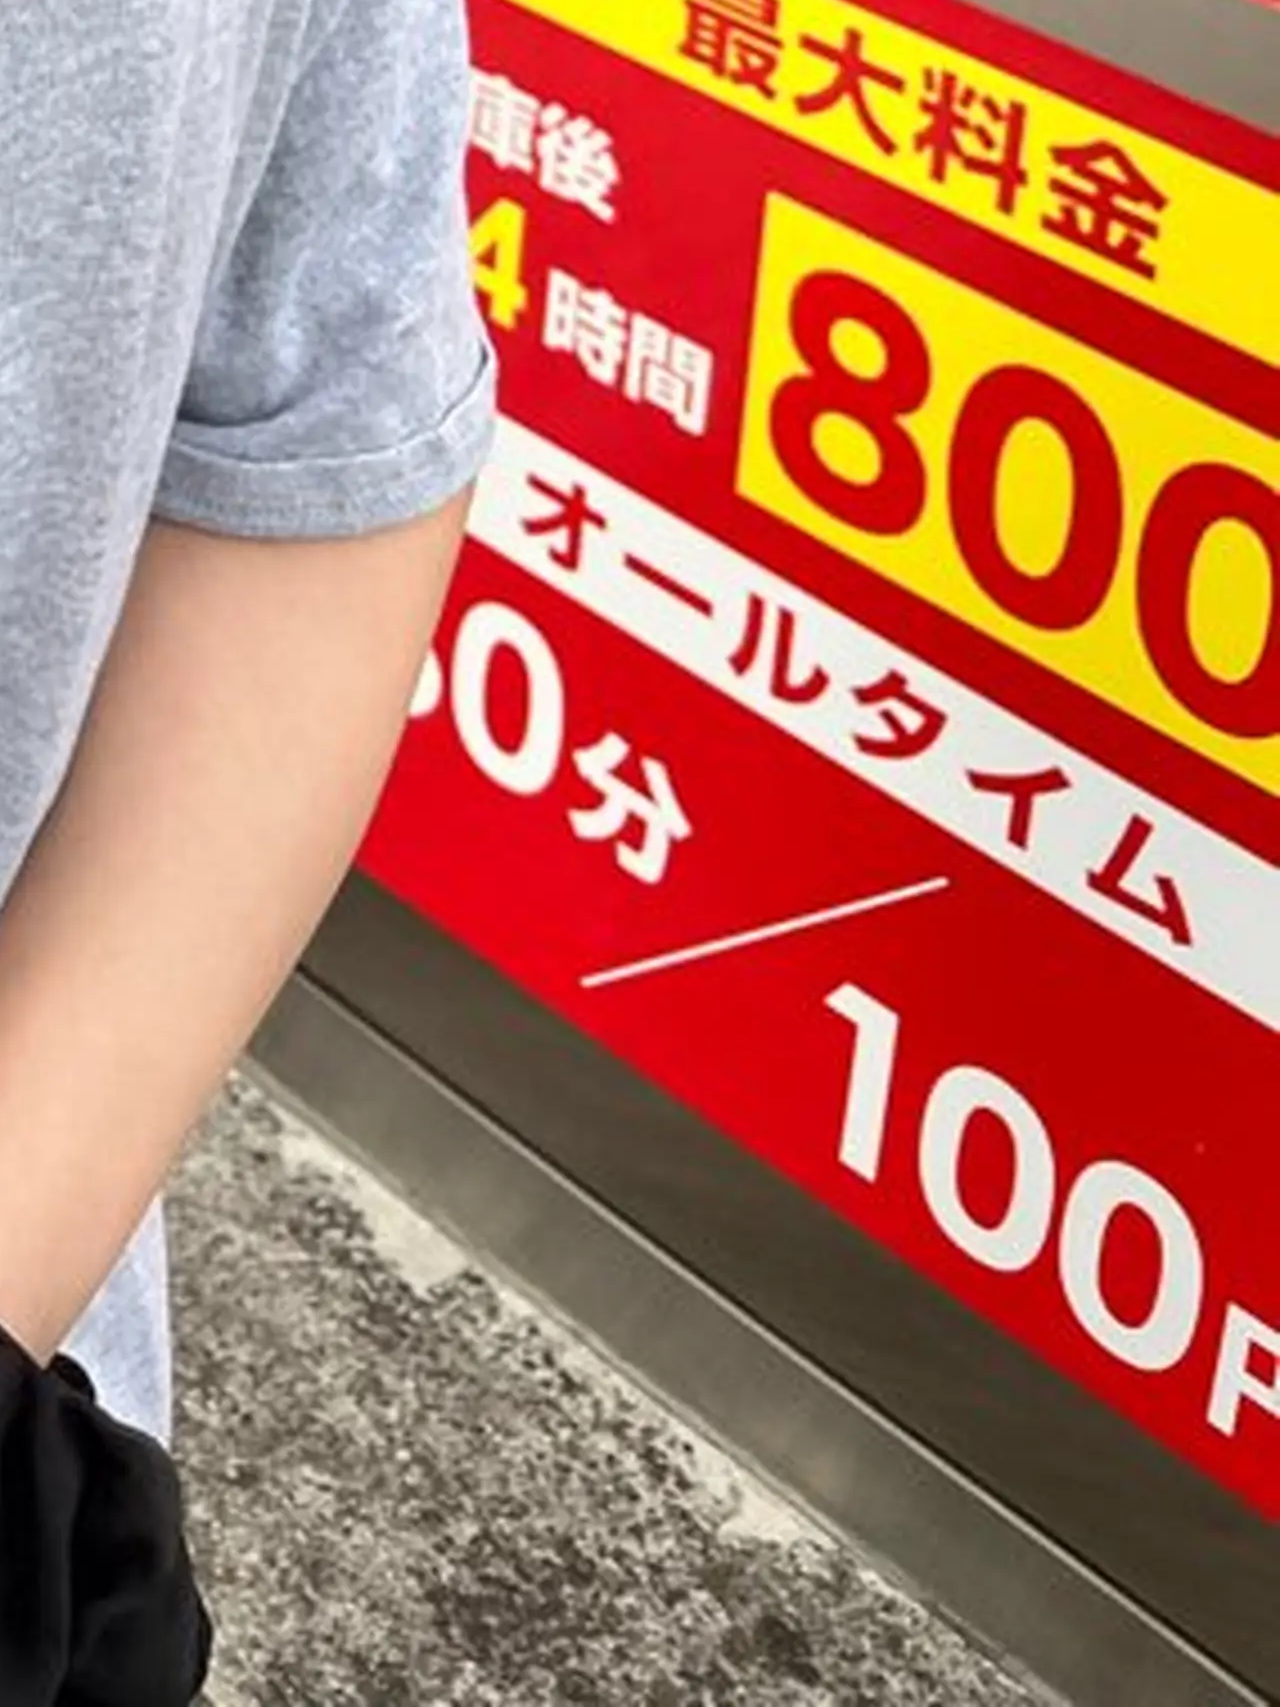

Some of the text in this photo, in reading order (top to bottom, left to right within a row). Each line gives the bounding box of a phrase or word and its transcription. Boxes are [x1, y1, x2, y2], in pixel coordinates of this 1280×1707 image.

[521, 473, 1194, 948] オールタイム
[768, 269, 1280, 740] 800
[408, 599, 693, 885] 0分
